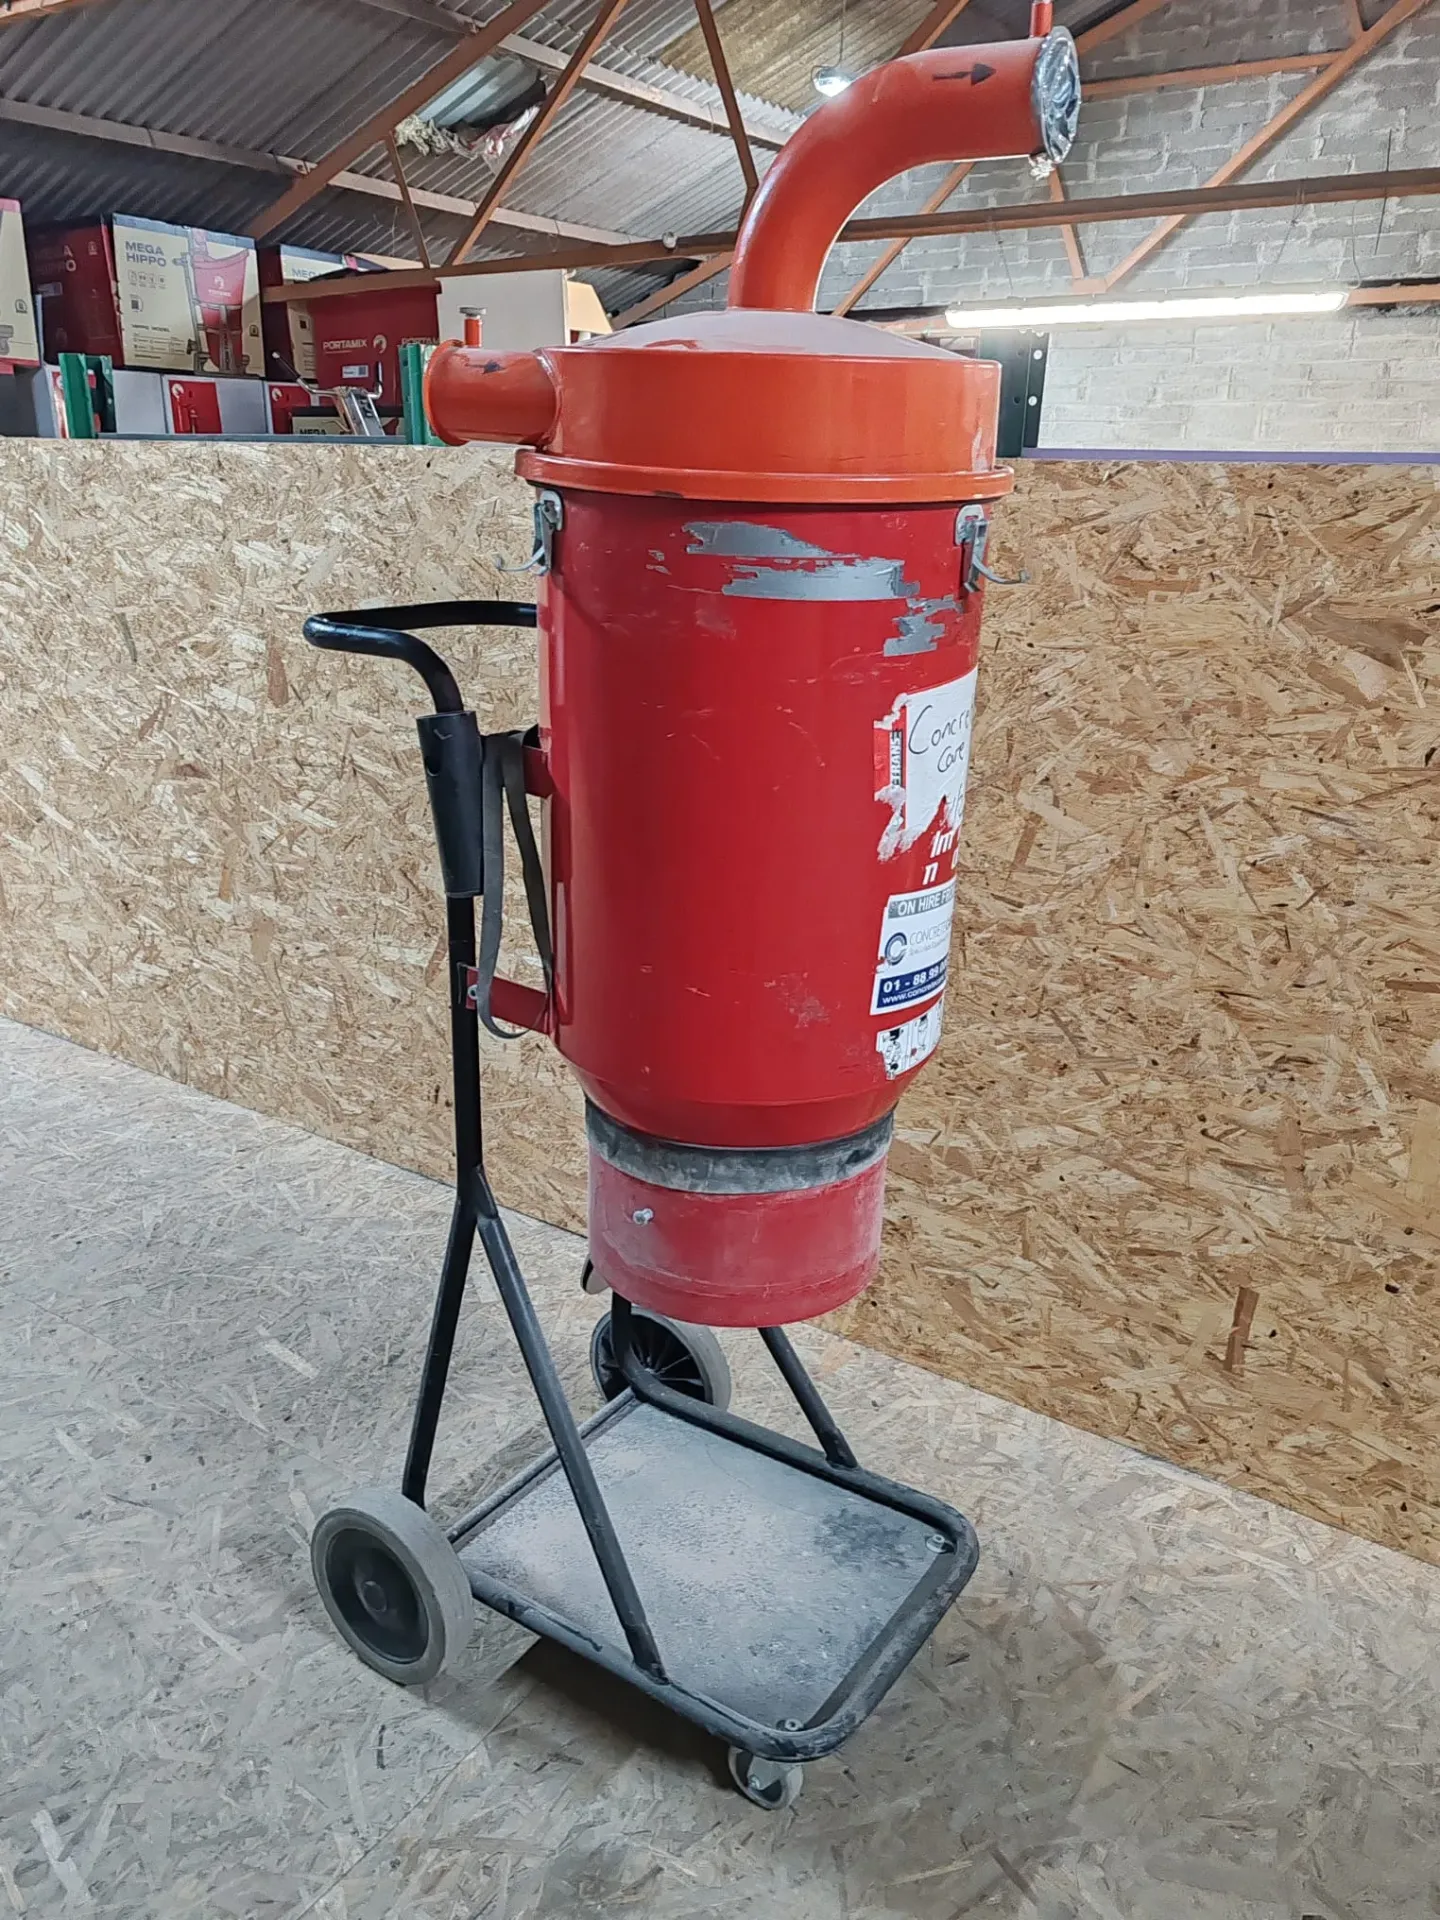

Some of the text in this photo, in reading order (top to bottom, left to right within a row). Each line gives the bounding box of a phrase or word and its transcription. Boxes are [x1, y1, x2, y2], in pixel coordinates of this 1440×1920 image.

[125, 241, 164, 256] MEGA
[126, 253, 167, 267] HIPPO
[323, 339, 368, 350] PORTAMIX
[897, 899, 916, 916] ON
[918, 893, 941, 912] HIRE
[883, 979, 901, 993] 01
